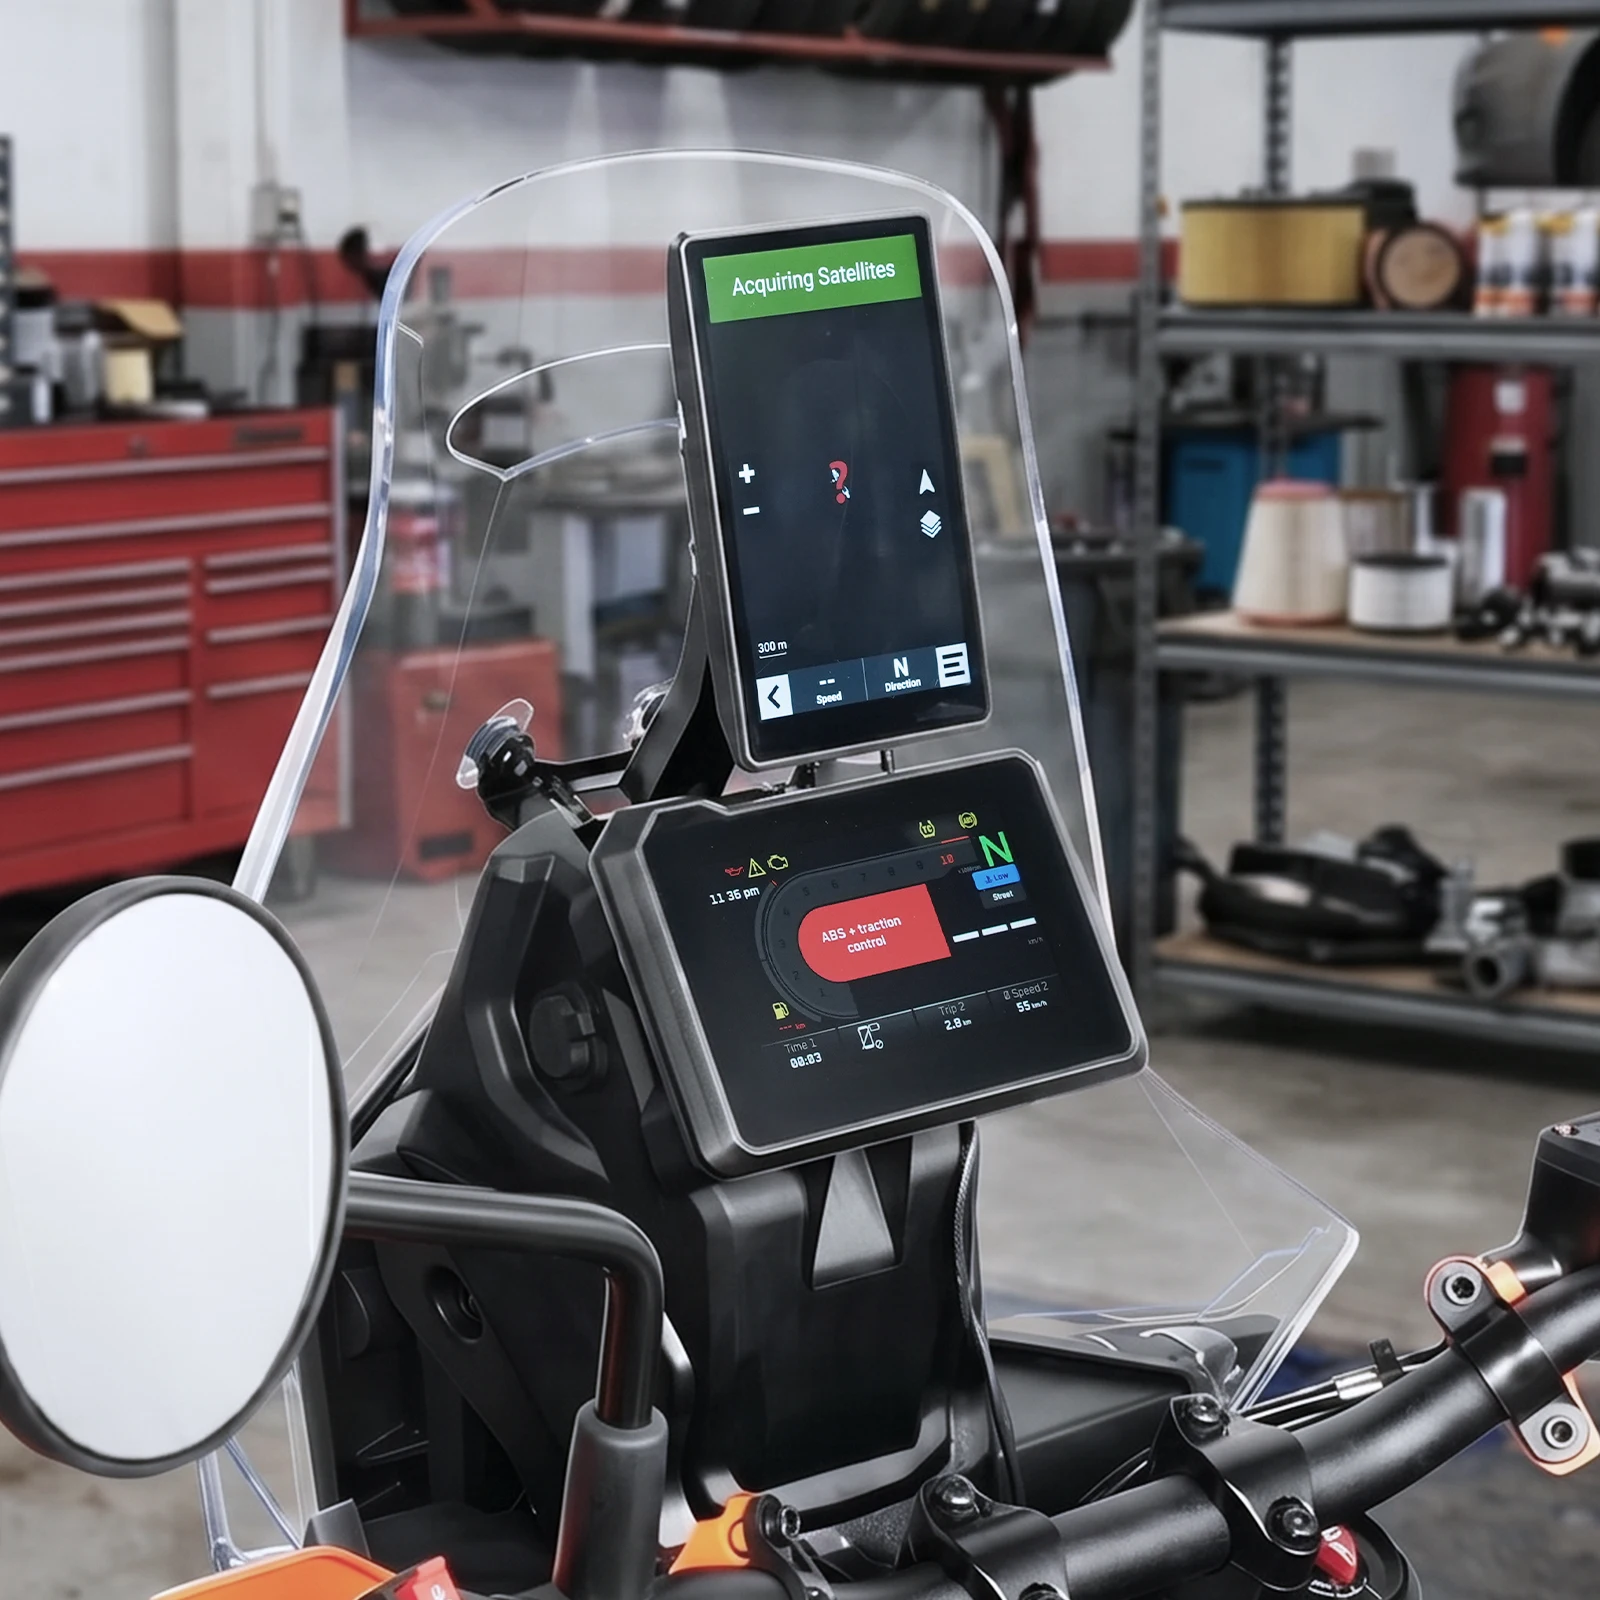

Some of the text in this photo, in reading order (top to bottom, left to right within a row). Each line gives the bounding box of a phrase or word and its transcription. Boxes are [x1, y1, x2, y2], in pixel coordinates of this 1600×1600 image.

[732, 261, 896, 298] Acquiring Satellites
[757, 640, 787, 654] 300 m
[893, 656, 910, 678] N
[884, 678, 922, 693] Direction
[816, 691, 843, 706] Speed
[922, 824, 933, 834] TC
[978, 831, 1014, 867] N
[940, 853, 955, 866] 10
[993, 872, 1009, 881] Low
[743, 886, 760, 900] pm
[992, 890, 1014, 901] Street
[821, 917, 902, 943] ABS + traction
[847, 934, 887, 954] control
[1011, 984, 1042, 998] Speed
[1041, 981, 1050, 991] 2
[938, 1001, 966, 1016] Trip 2
[1016, 1000, 1048, 1013] 55 km/h
[795, 1022, 806, 1031] km
[944, 1017, 972, 1031] 2.8 km
[784, 1038, 817, 1054] Time 1
[789, 1051, 823, 1069] 00:03
